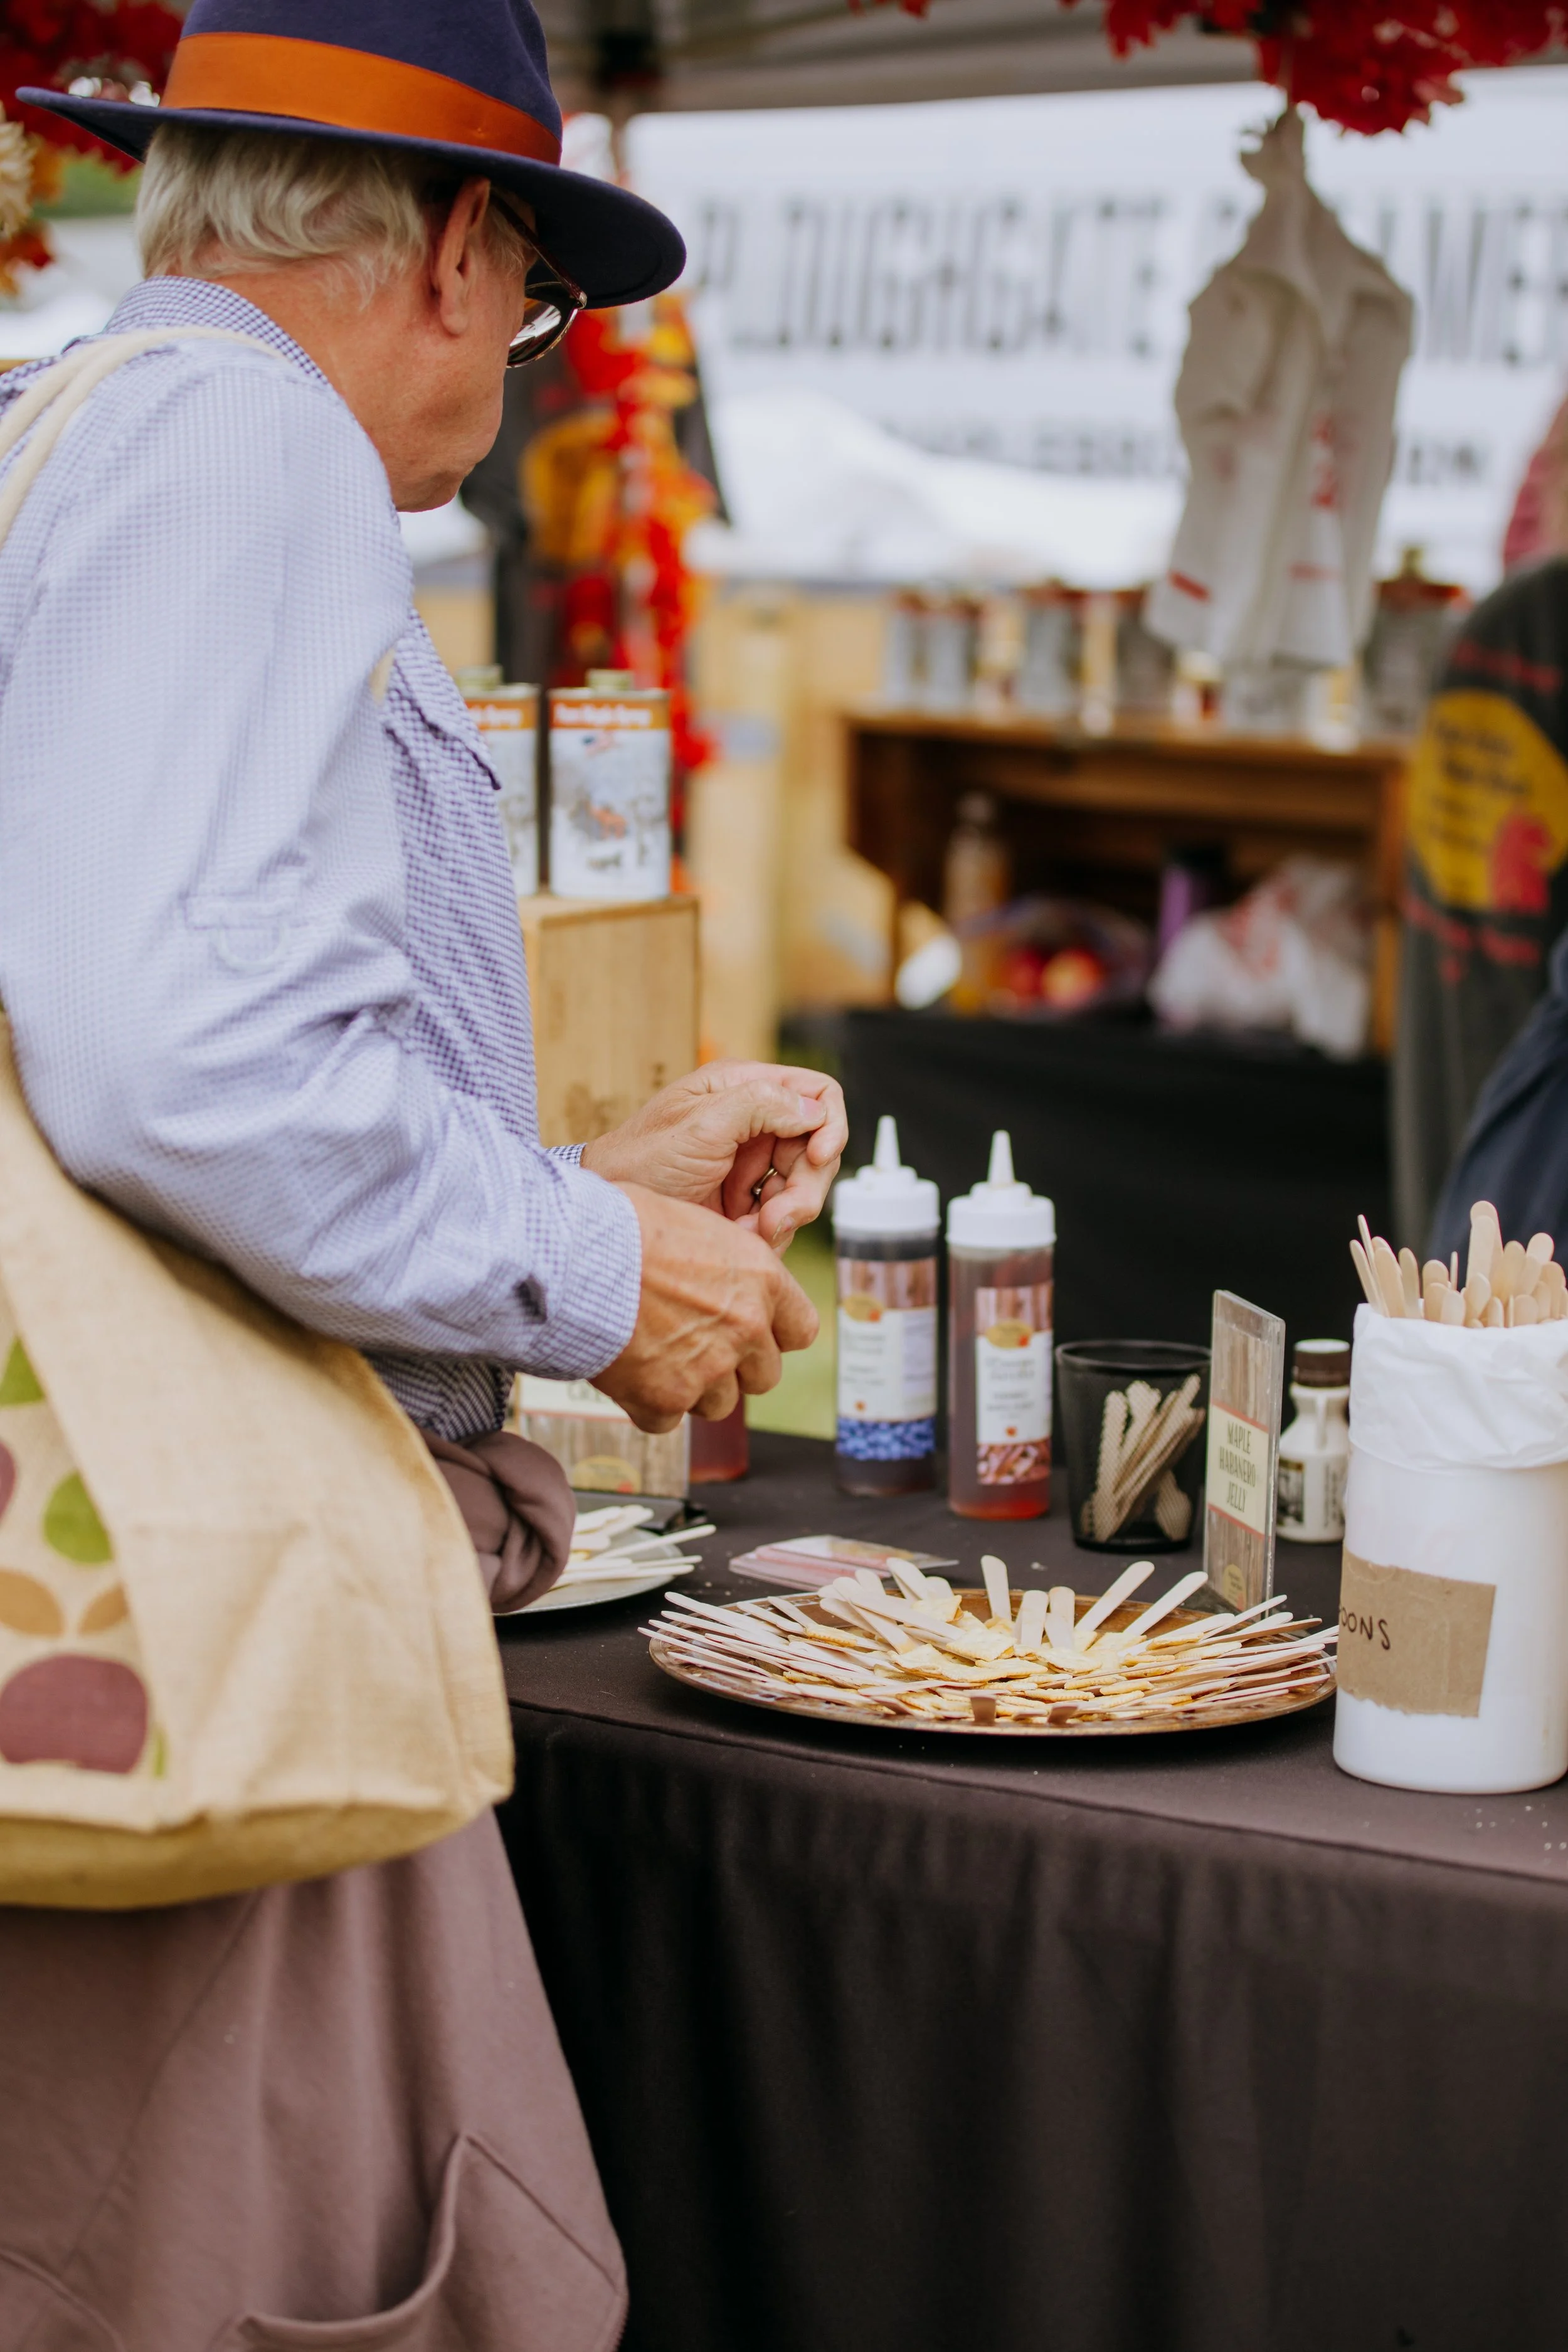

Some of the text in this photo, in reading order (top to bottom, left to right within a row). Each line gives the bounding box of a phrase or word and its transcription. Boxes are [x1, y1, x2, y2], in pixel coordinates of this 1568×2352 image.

[1227, 1420, 1252, 1454] MAPLE
[1219, 1445, 1256, 1488] HABANERO
[1227, 1481, 1248, 1513] JELLY
[1338, 1606, 1391, 1650] OONS
